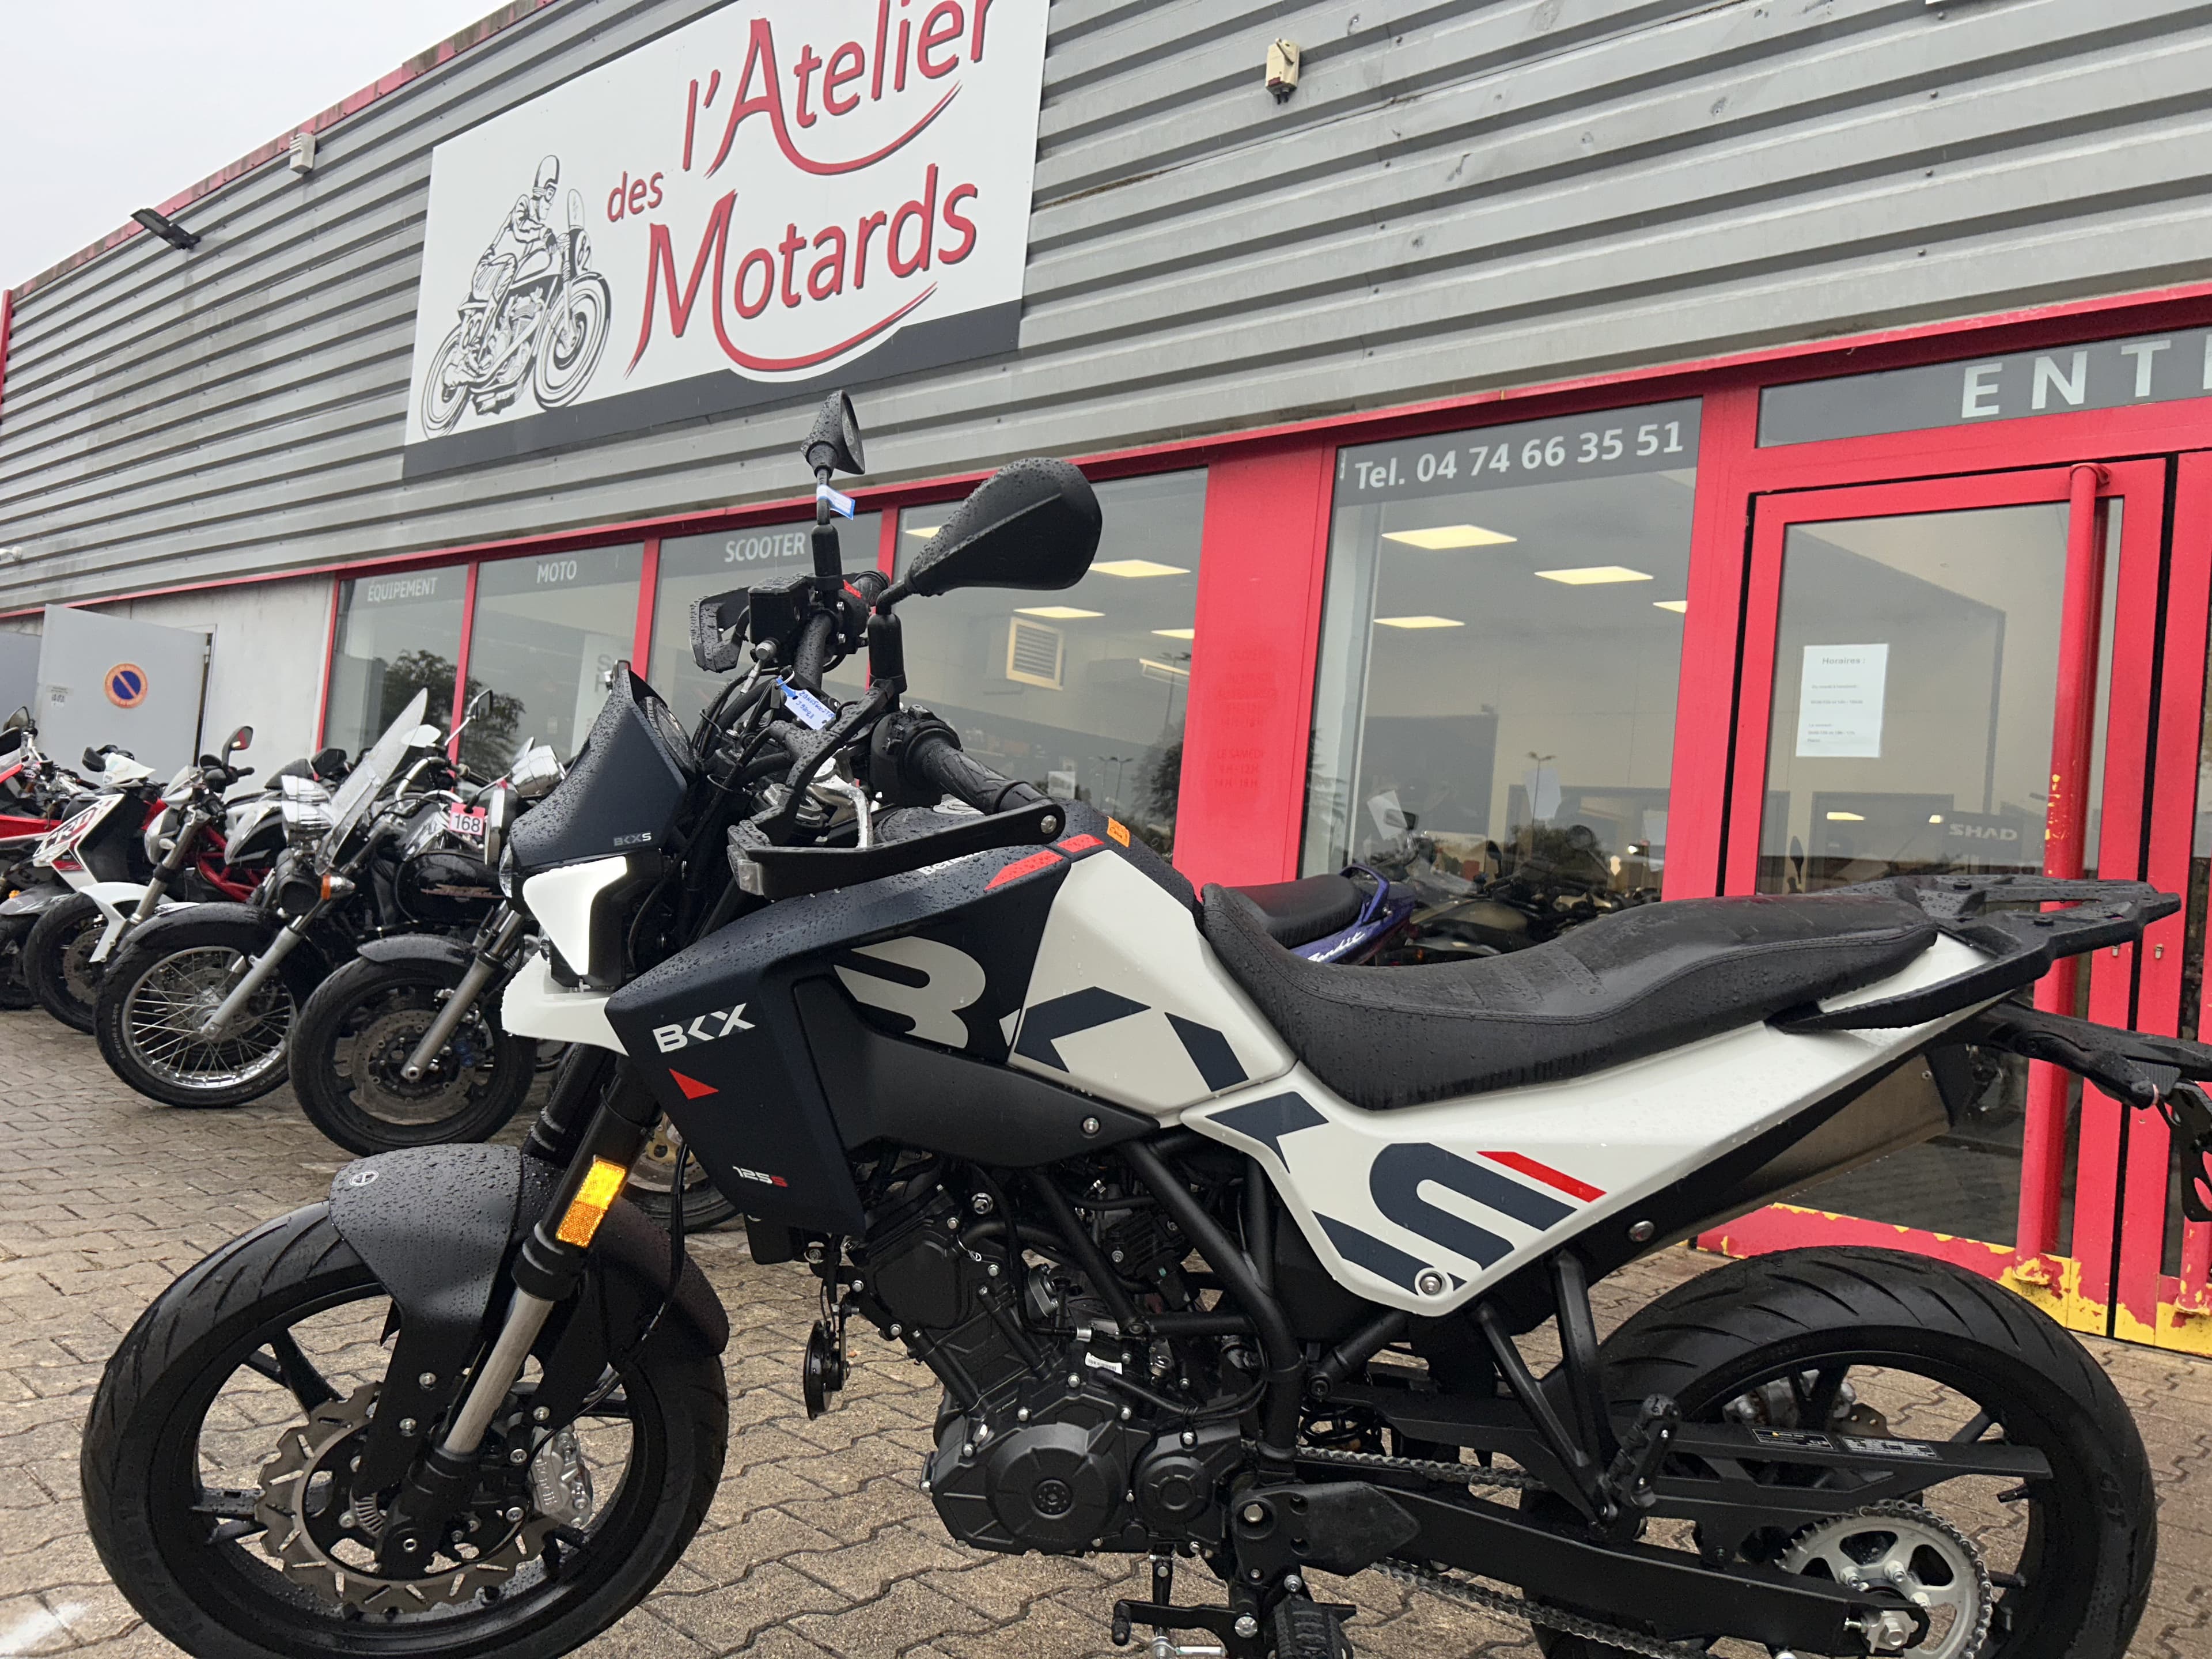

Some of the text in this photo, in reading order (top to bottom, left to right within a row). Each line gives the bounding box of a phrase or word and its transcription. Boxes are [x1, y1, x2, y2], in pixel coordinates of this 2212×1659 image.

[683, 0, 994, 179] l'Atelier
[607, 171, 664, 222] des
[624, 163, 979, 378] Motards
[1355, 421, 1684, 490] Tel. 04 74 66 35 51
[536, 559, 577, 584] MOTO
[724, 532, 806, 563] SCOOTER
[453, 815, 481, 833] 168
[1948, 823, 2018, 841] SHAD
[652, 1002, 756, 1054] BKX
